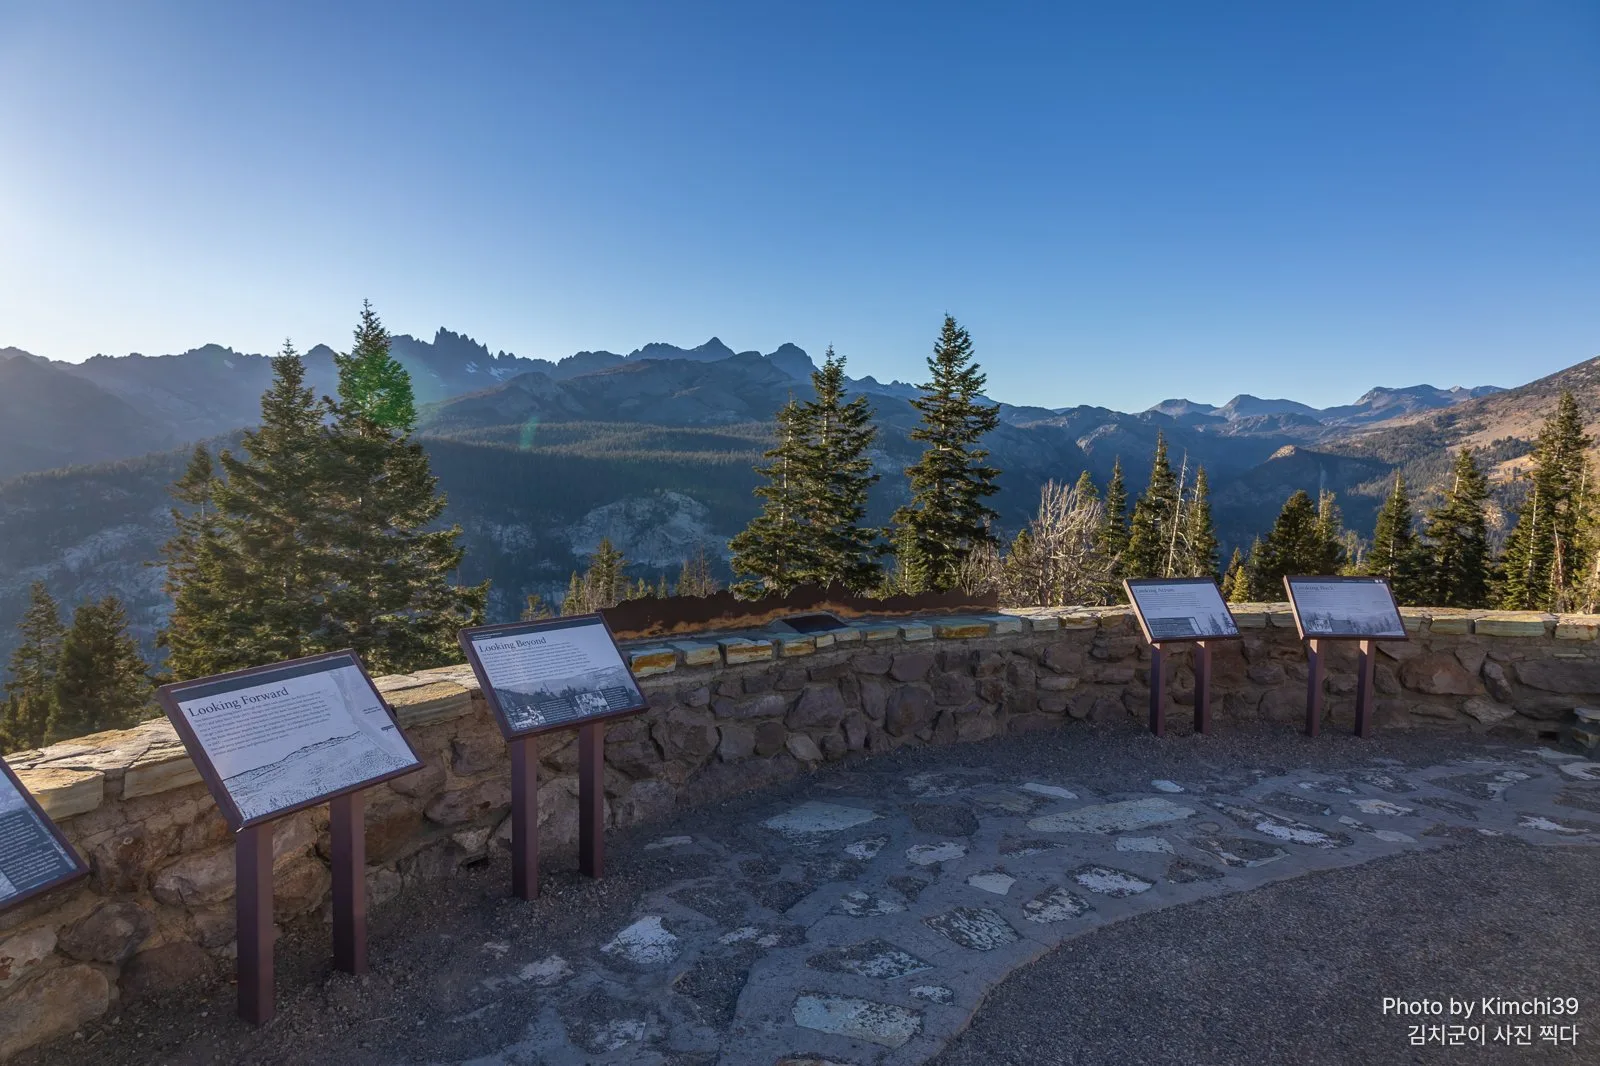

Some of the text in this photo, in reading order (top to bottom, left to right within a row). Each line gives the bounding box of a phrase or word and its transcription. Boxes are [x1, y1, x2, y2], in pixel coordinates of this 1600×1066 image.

[479, 636, 547, 653] Looking Beyond
[188, 686, 289, 717] Looking Forward
